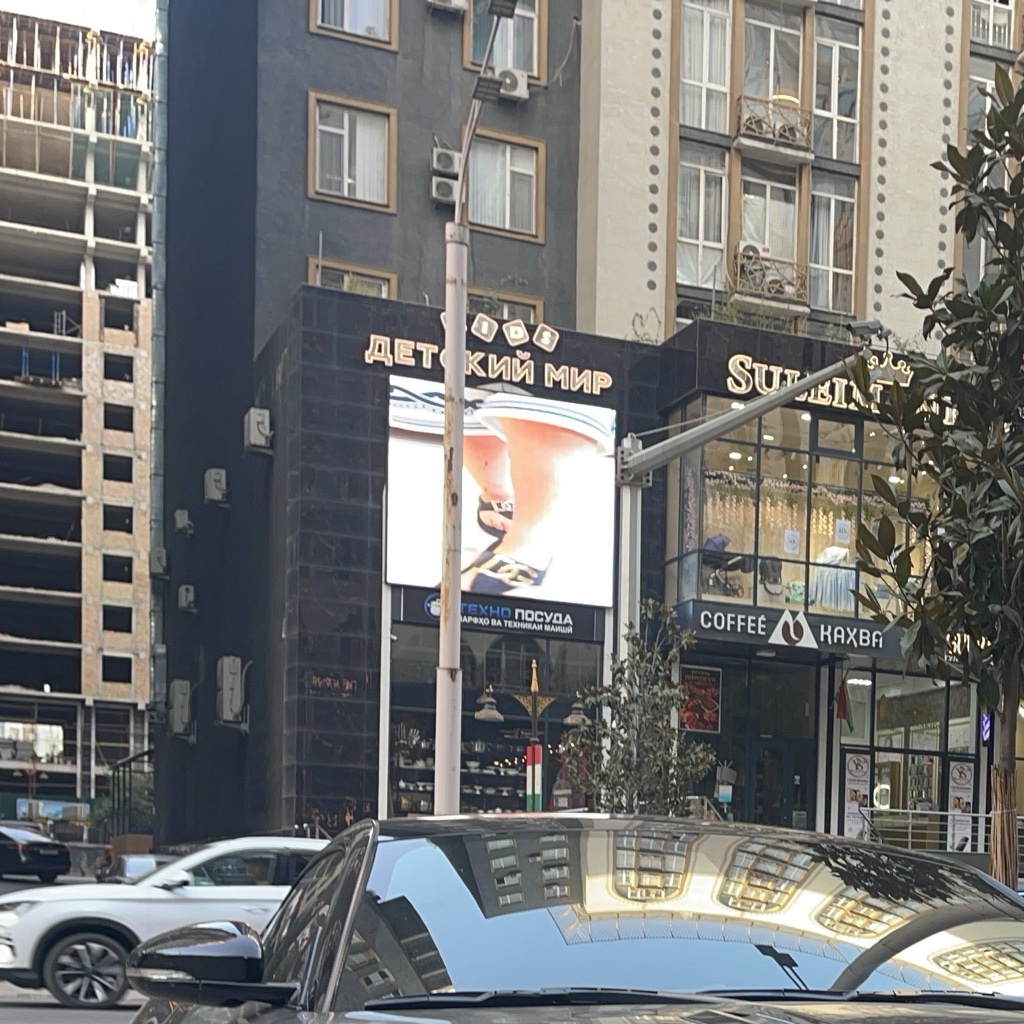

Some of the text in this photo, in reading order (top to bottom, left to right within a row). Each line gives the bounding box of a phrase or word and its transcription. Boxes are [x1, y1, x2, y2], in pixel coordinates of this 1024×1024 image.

[470, 316, 556, 349] IDS
[544, 362, 613, 395] МИР
[460, 602, 574, 626] ТЕХНО ПОСУДА
[491, 618, 502, 628] ВА
